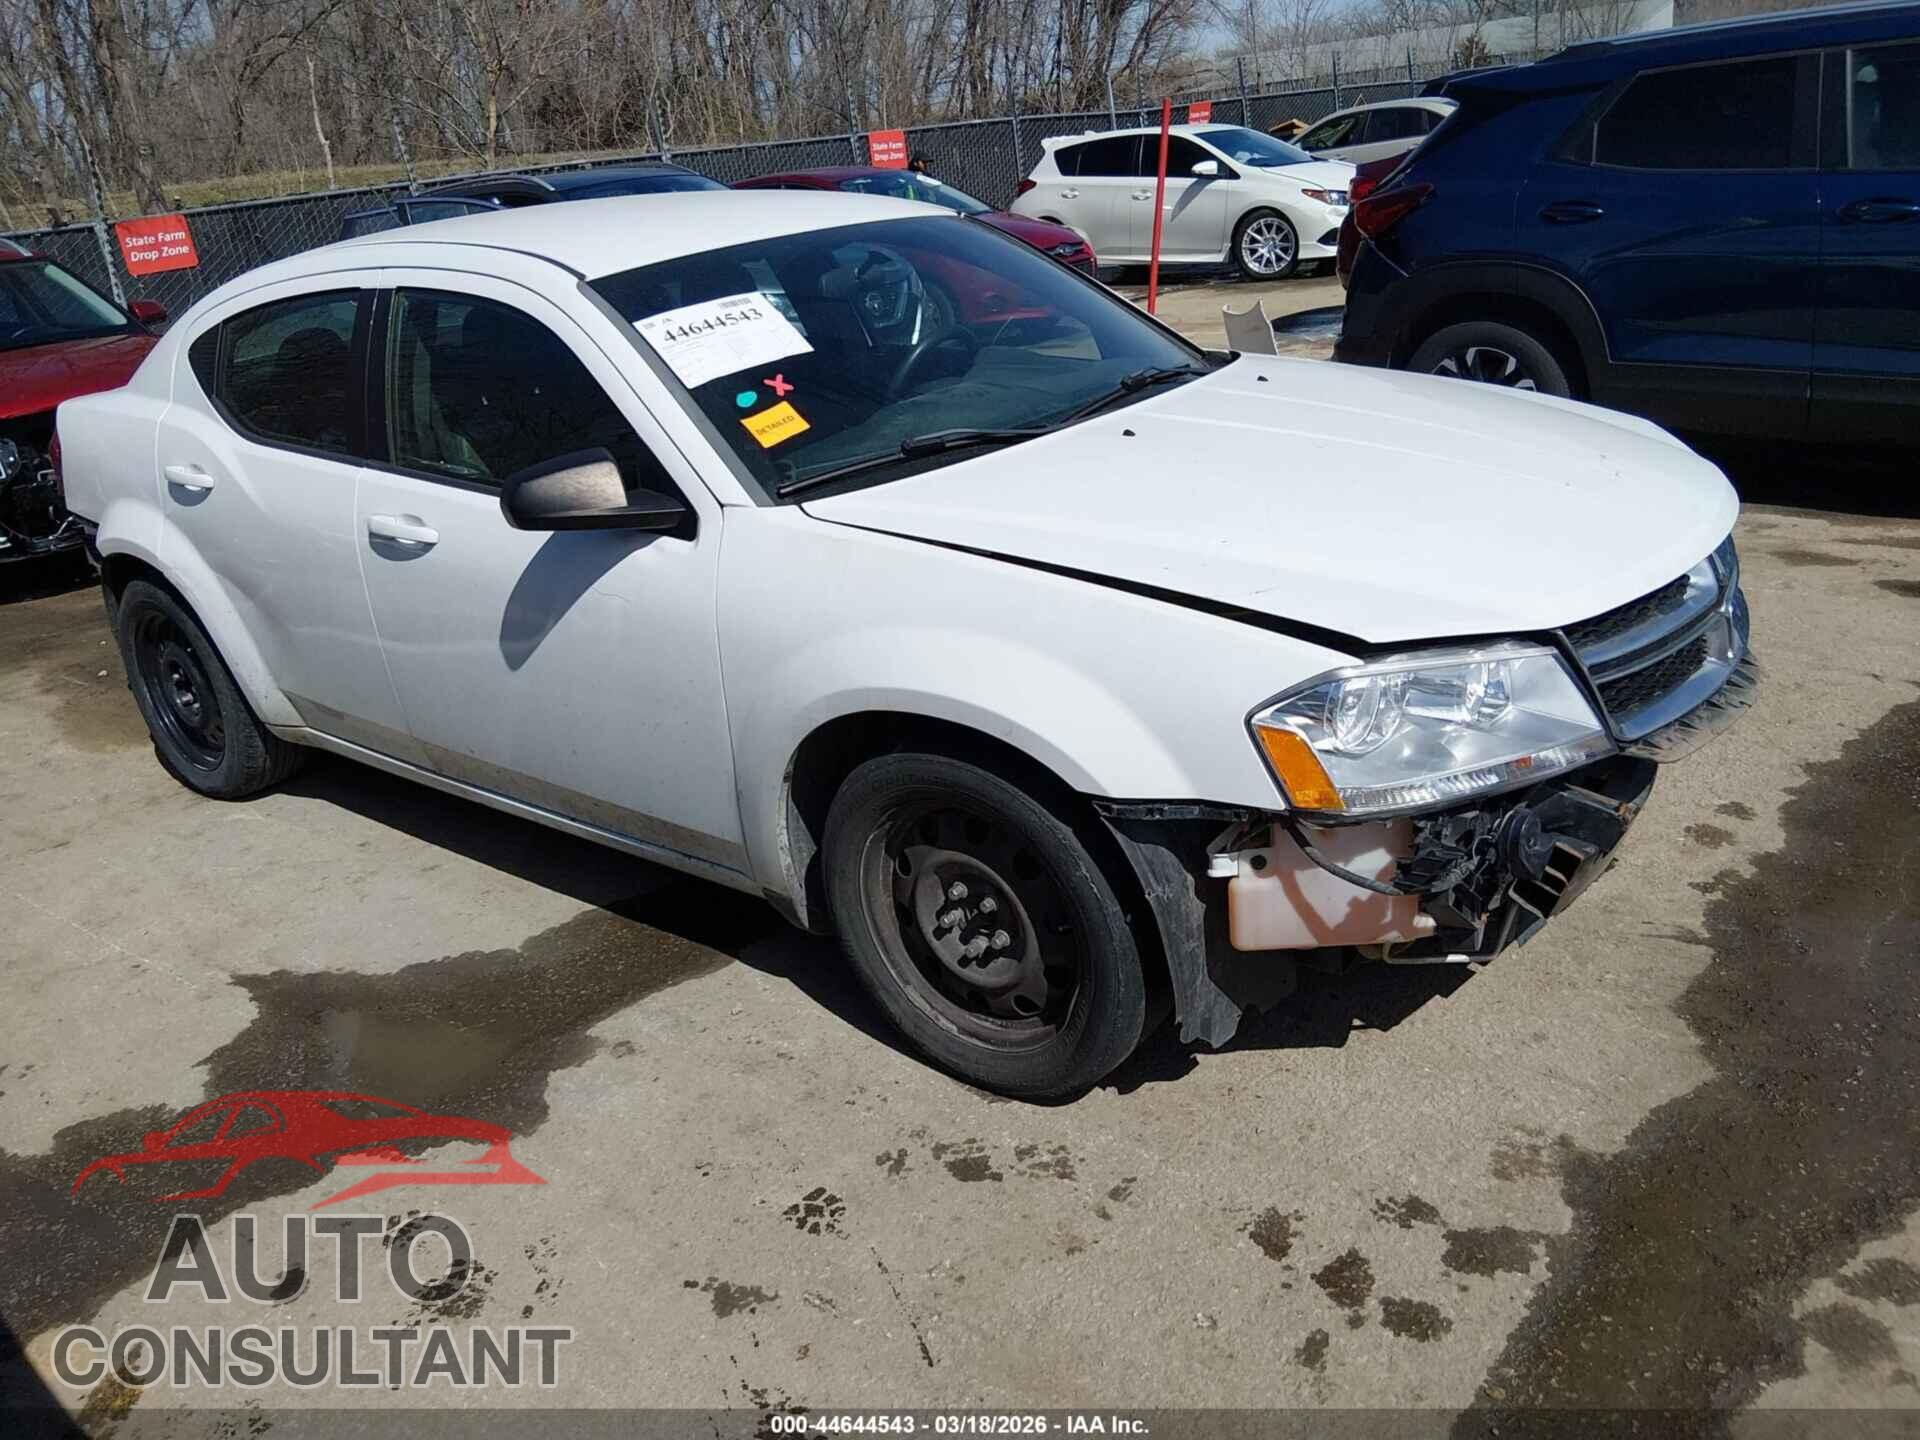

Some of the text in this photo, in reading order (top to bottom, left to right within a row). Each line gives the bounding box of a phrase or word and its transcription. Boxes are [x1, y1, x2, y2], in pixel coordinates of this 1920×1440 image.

[125, 231, 186, 248] State Farm
[130, 245, 190, 262] Drop Zone
[663, 307, 764, 343] 44644543
[755, 415, 796, 436] DETAILED
